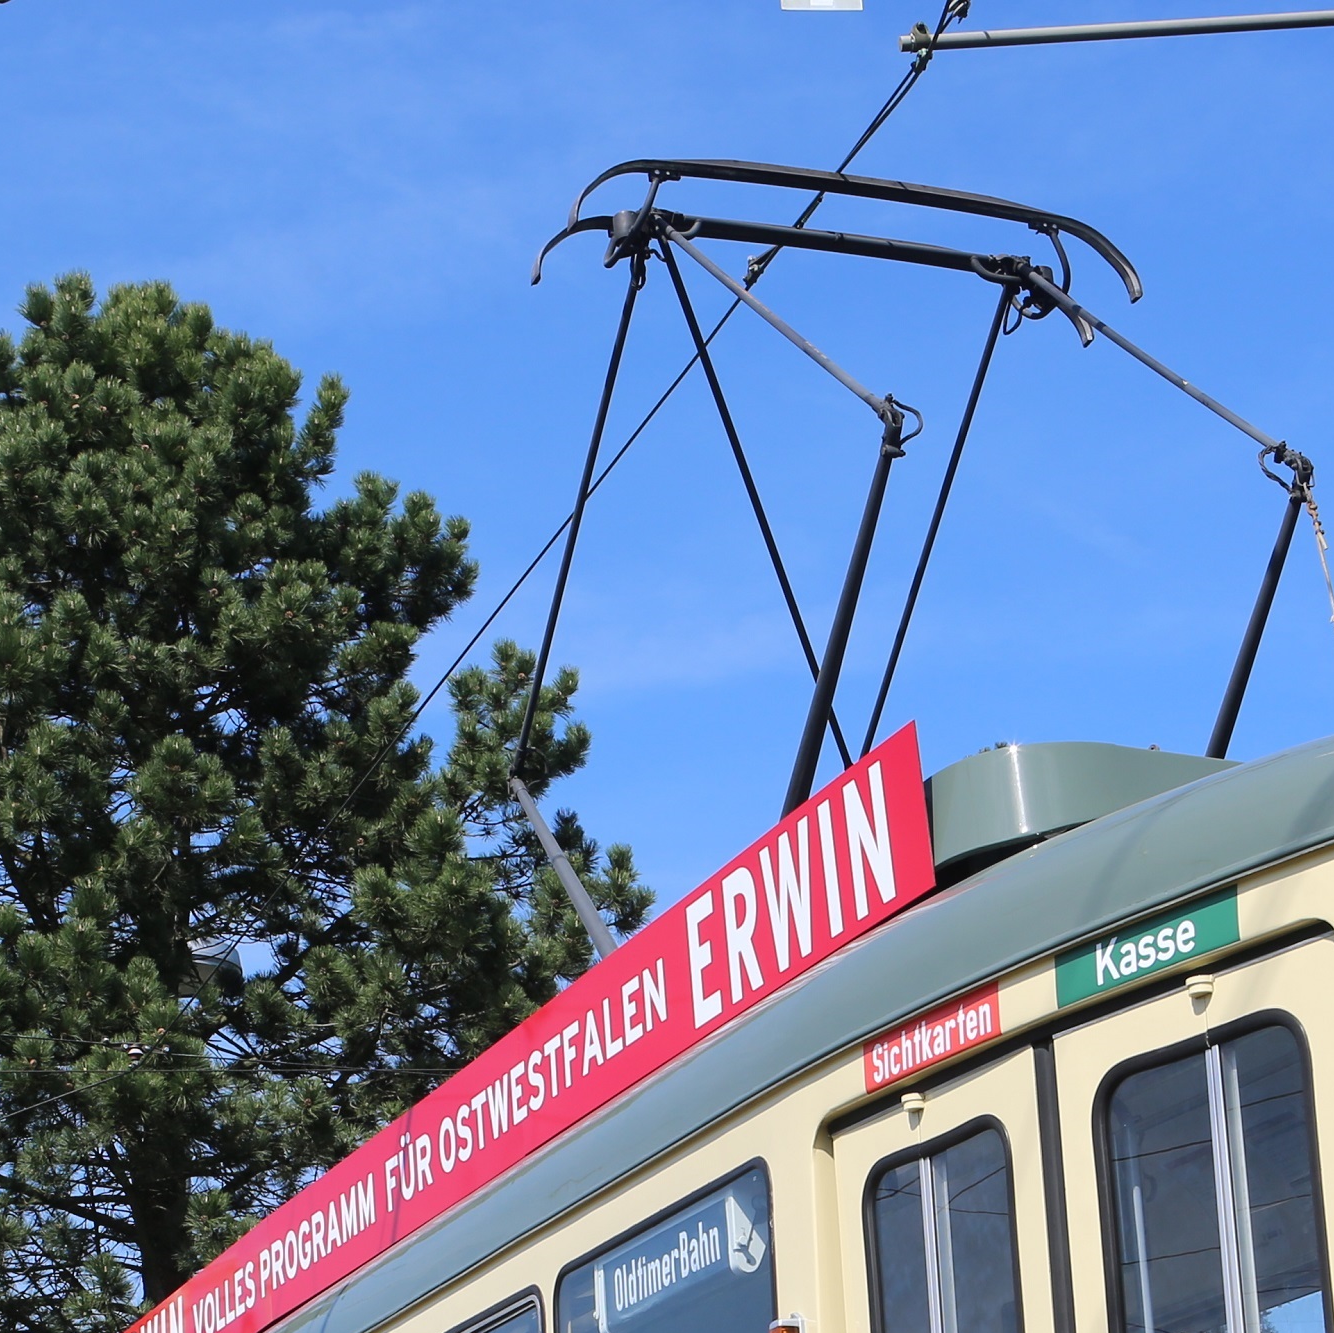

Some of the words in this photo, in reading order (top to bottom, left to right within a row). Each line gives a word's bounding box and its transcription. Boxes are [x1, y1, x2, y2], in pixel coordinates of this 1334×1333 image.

[1094, 919, 1196, 987] Kasse
[259, 1172, 376, 1299] PROGRAMM
[384, 1130, 434, 1213] FÜR
[437, 956, 668, 1174] OSTWESTFALEN
[685, 760, 897, 1030] ERWIN
[871, 1000, 992, 1084] Sichtkarten
